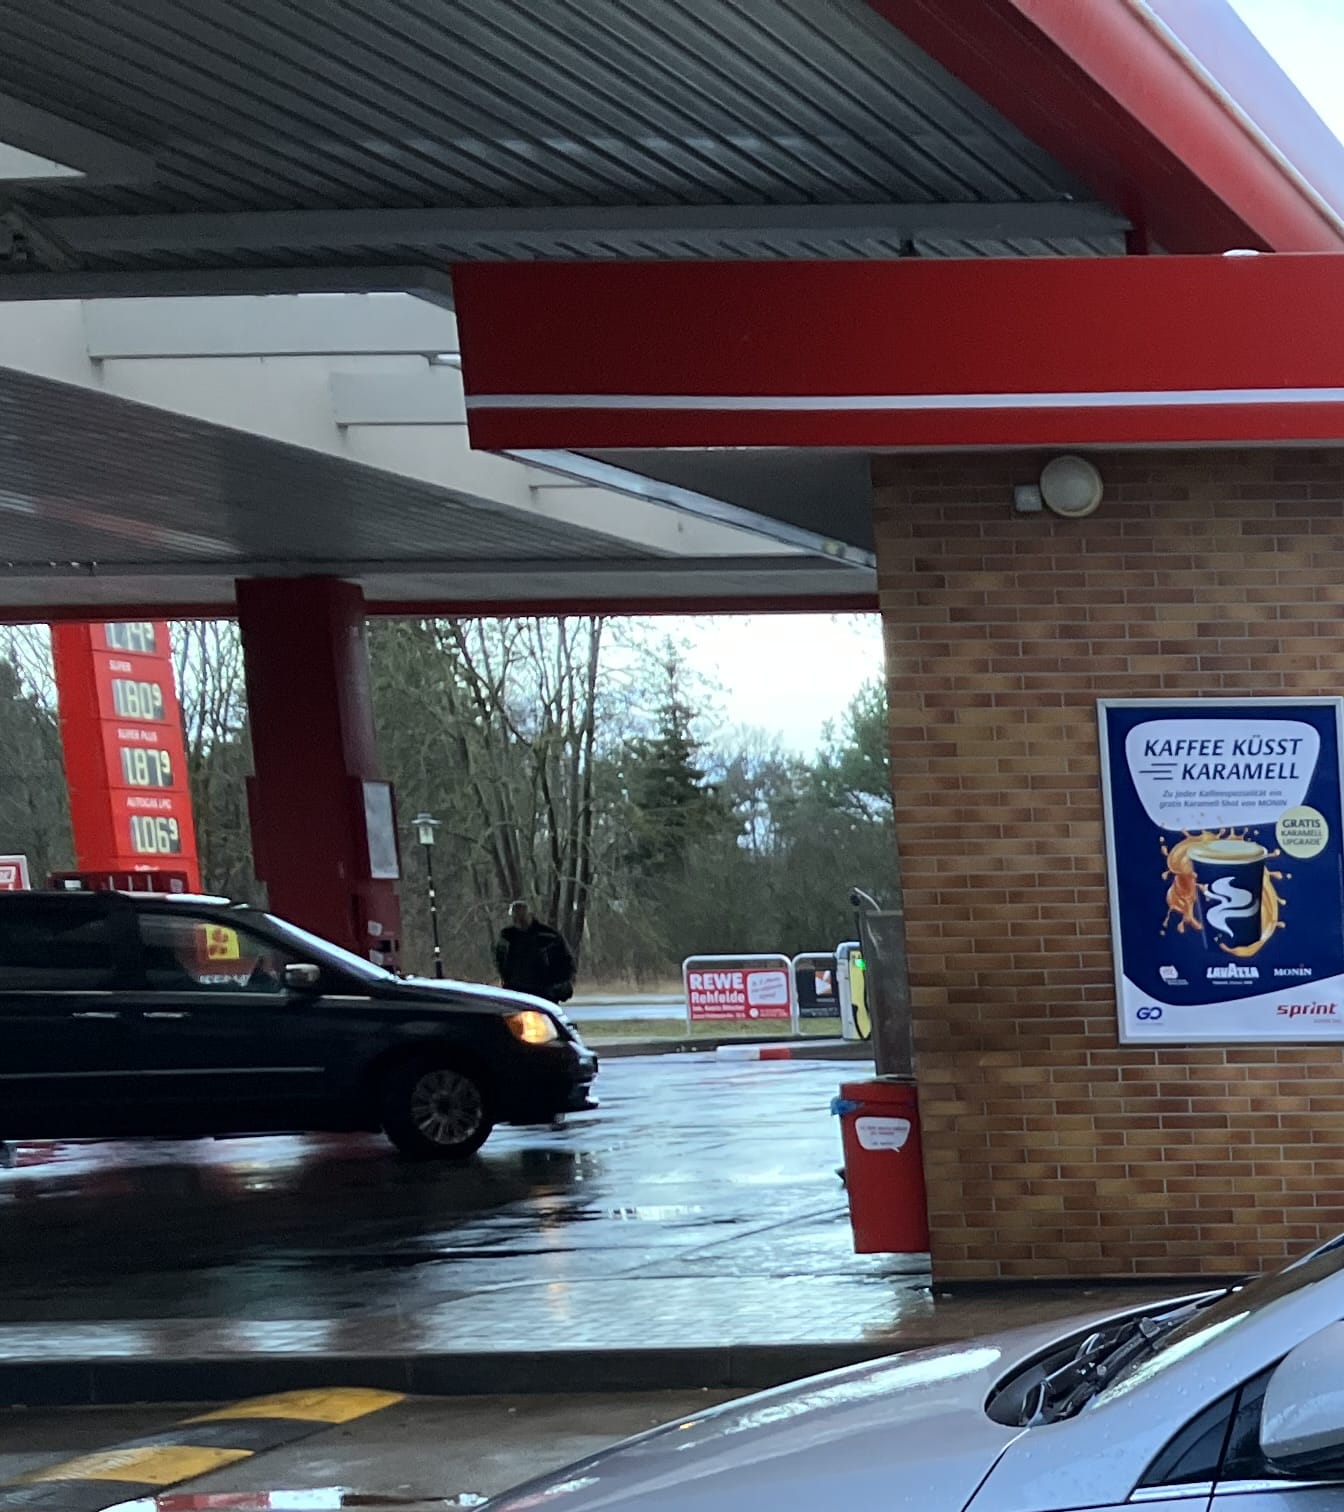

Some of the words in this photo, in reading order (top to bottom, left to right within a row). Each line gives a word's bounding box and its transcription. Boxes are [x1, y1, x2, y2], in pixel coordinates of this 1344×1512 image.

[1144, 739, 1225, 757] KAFFEE
[1232, 734, 1303, 756] KÜSST
[1182, 762, 1300, 780] KARAMELL
[1282, 819, 1321, 828] GRATIS
[1281, 829, 1322, 837] KARAMELL
[1282, 838, 1320, 846] UPGRADE
[1206, 963, 1260, 979] LAVAZZA
[1273, 964, 1312, 977] MONIN
[689, 972, 744, 990] REWE
[1136, 1006, 1163, 1020] GO
[1276, 1001, 1338, 1019] sprint
